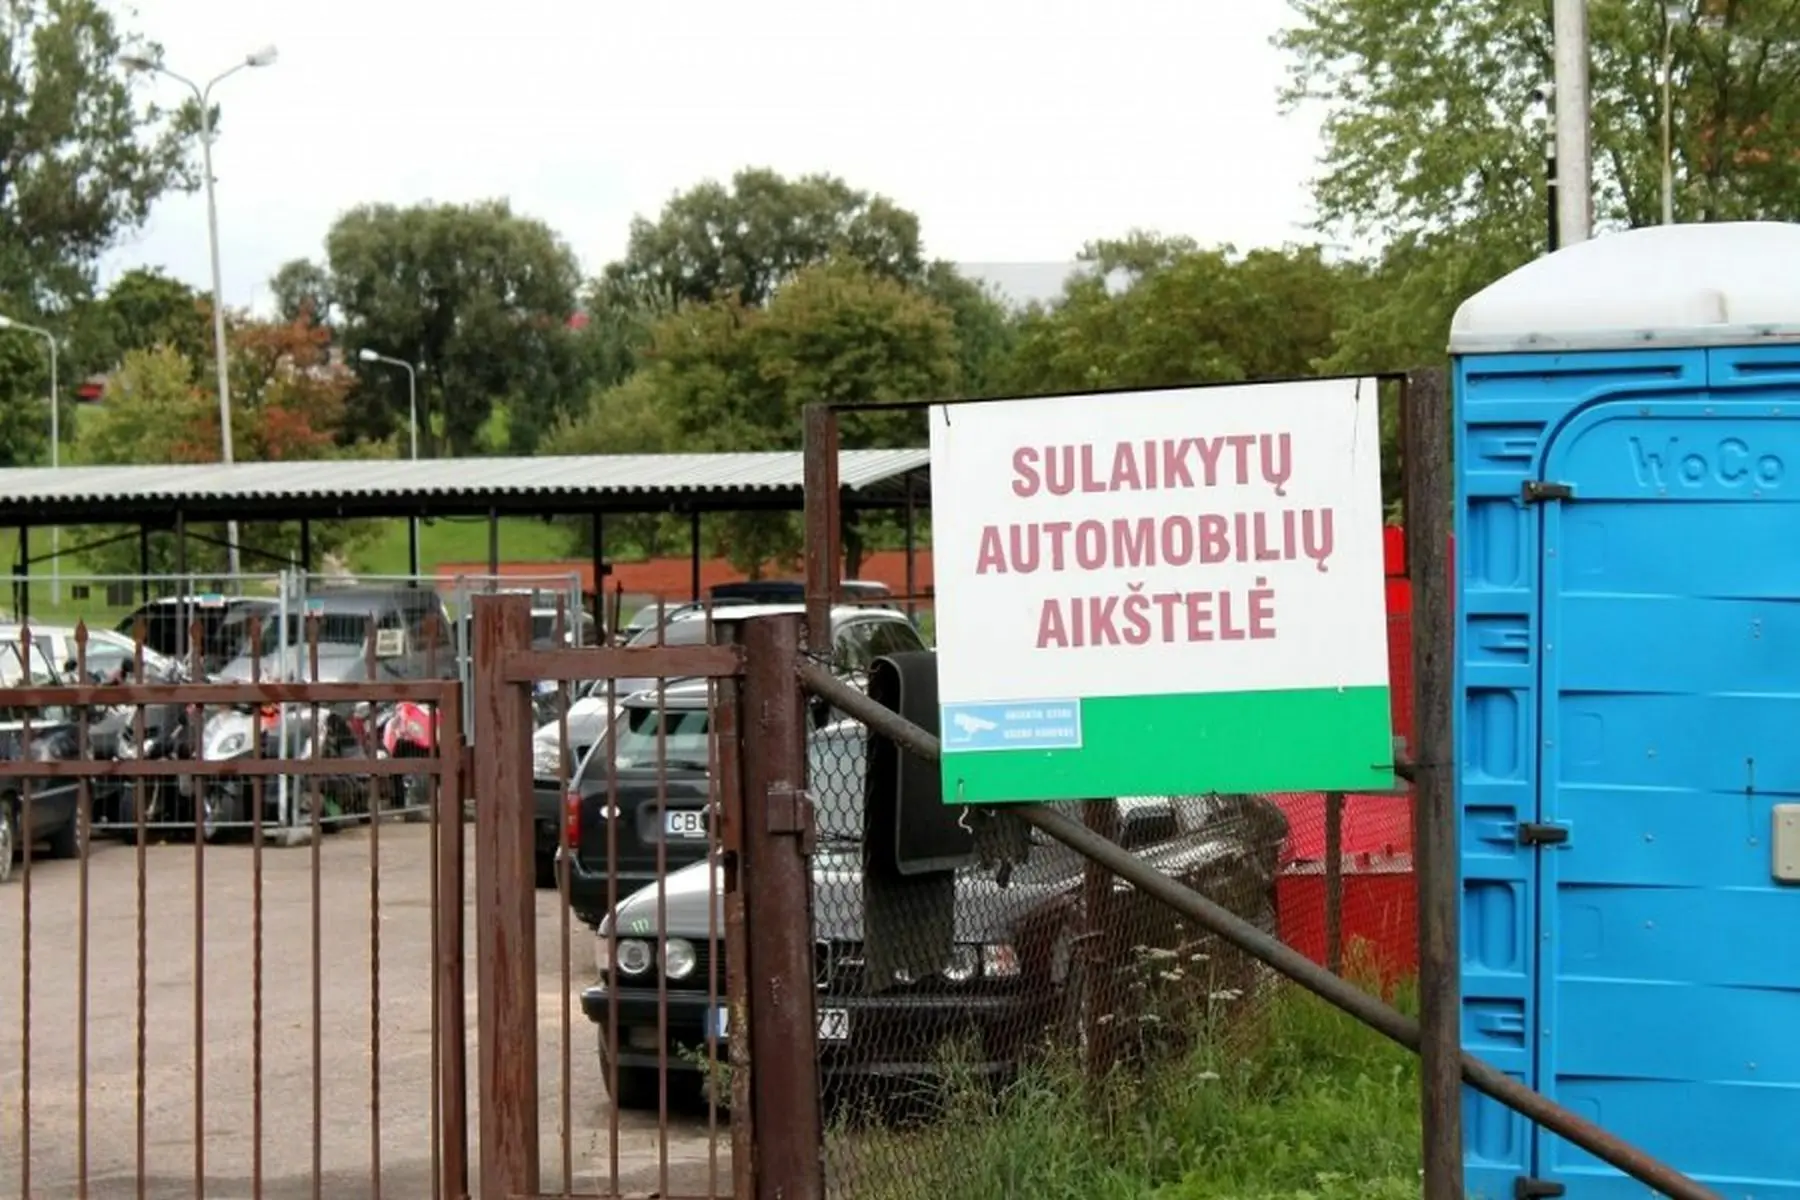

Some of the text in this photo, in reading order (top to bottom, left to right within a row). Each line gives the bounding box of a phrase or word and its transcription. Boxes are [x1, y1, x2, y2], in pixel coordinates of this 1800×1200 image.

[1011, 432, 1292, 497] SULAIKYTŲ
[976, 508, 1334, 573] AUTOMOBILIŲ
[1036, 577, 1277, 649] AIKŠTELĖ
